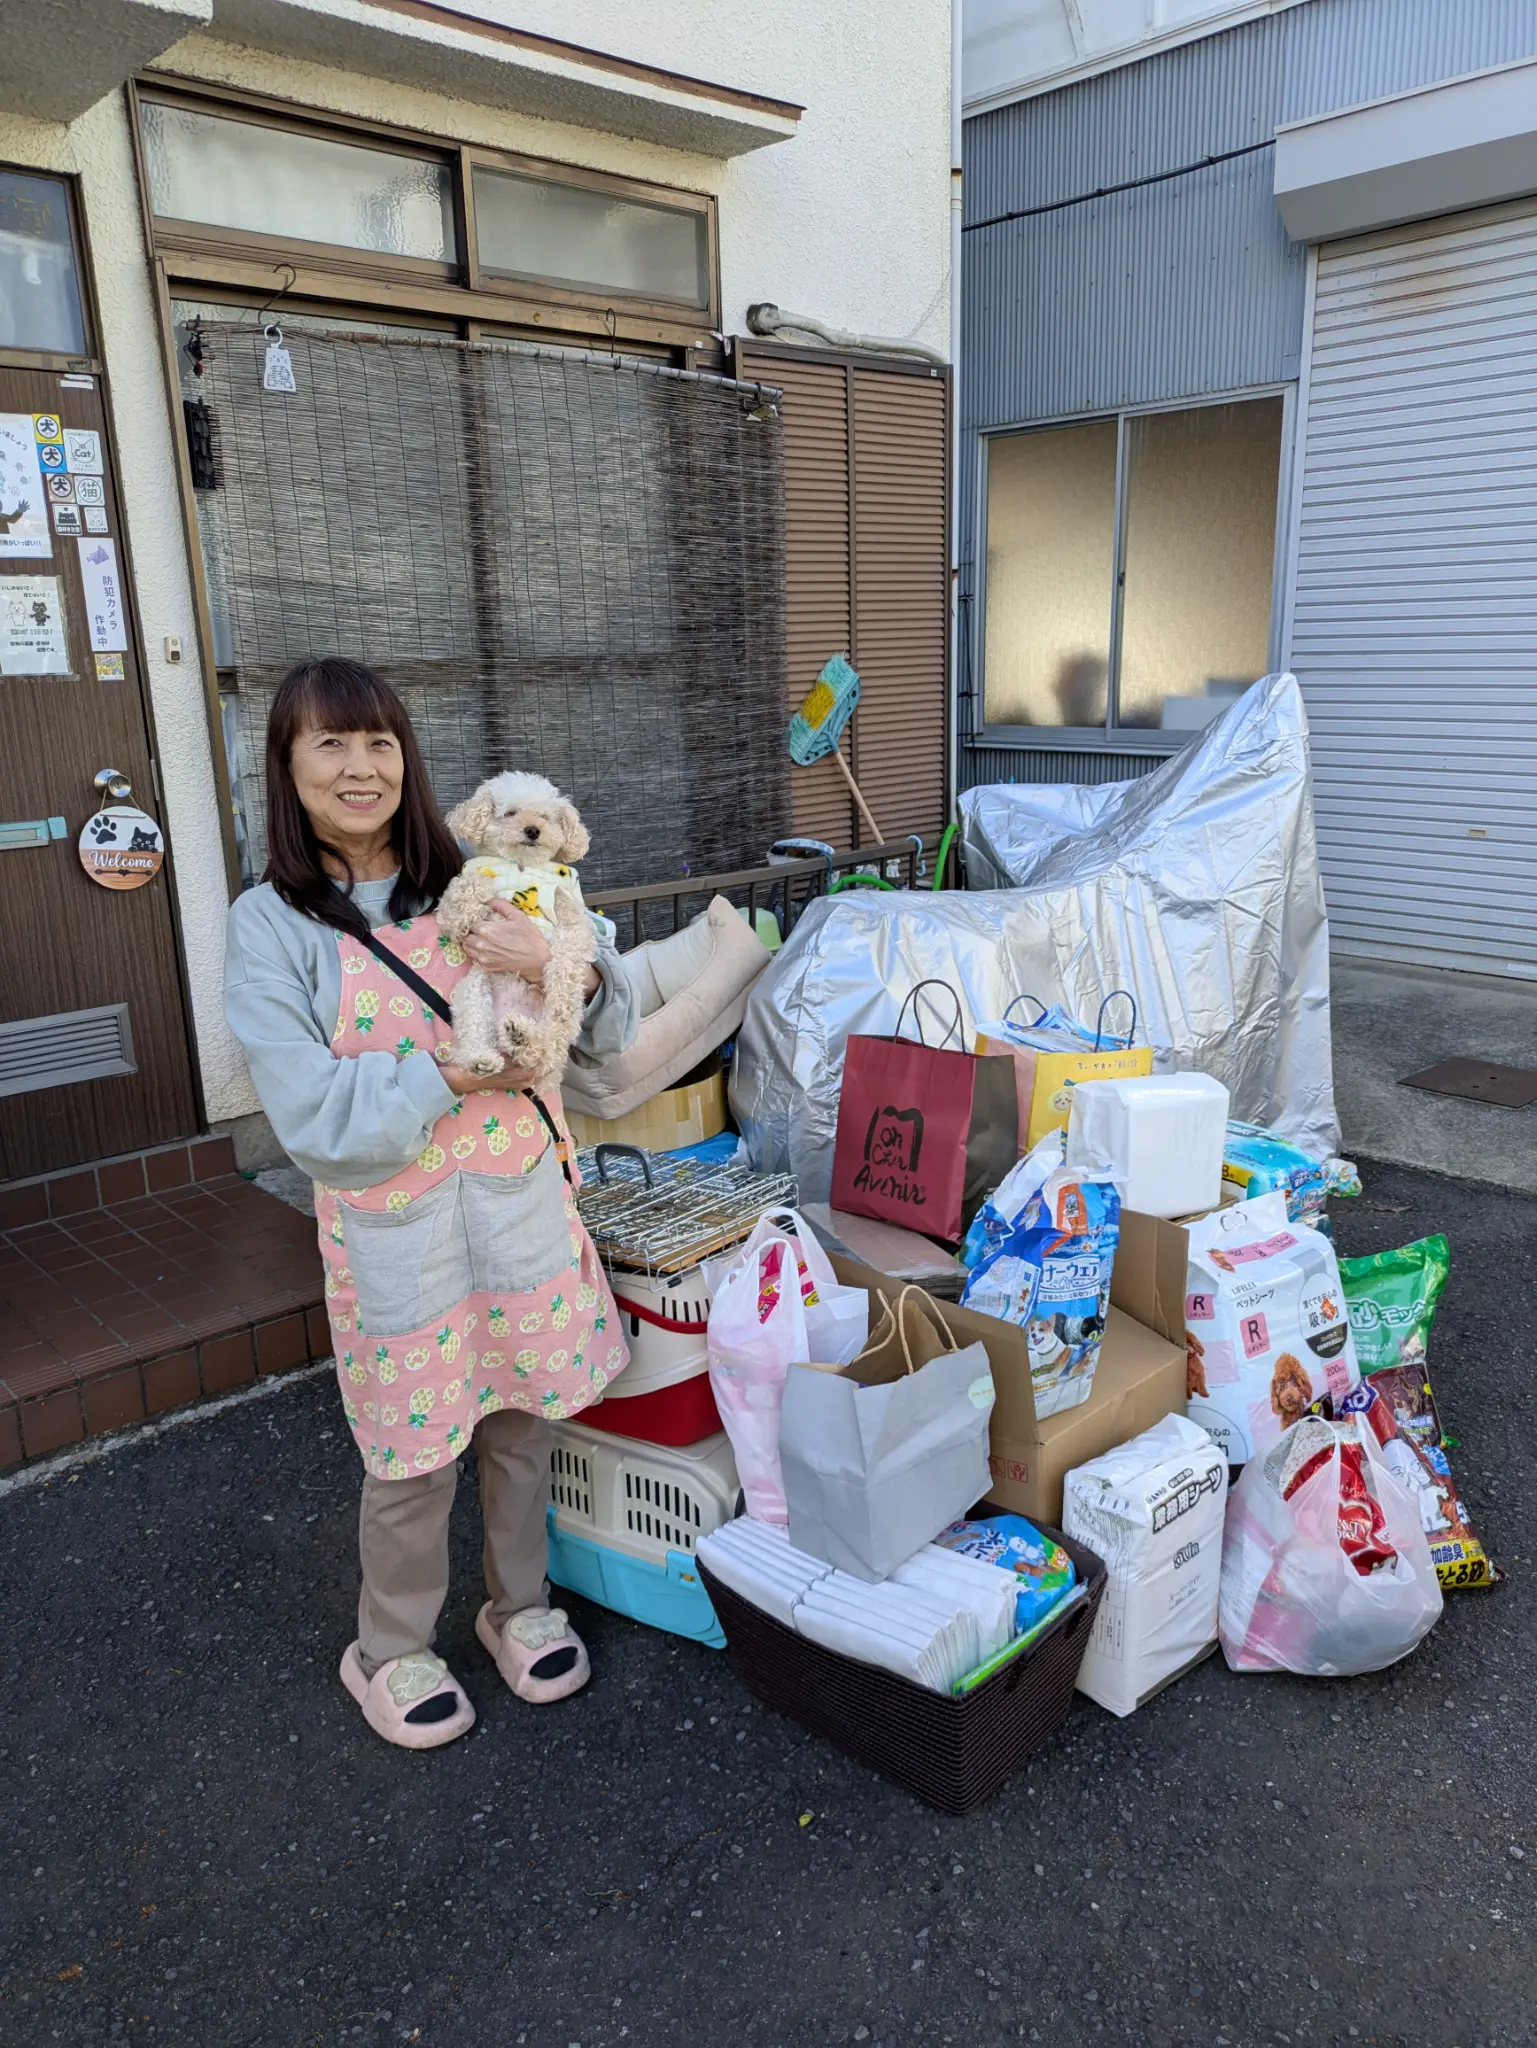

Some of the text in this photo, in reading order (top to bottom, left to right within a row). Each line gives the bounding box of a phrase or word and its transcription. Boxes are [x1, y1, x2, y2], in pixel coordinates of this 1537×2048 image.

[39, 418, 55, 433] 犬
[44, 447, 60, 462] 犬
[74, 449, 92, 458] Cat
[53, 478, 69, 492] 犬
[80, 481, 98, 498] 猫
[102, 575, 118, 631] 防犯カメラ
[94, 615, 108, 648] 作動中
[88, 851, 155, 868] Welcome
[853, 1163, 927, 1205] Avenir
[1231, 1281, 1257, 1295] LIFELEX
[1193, 1296, 1205, 1310] R
[1236, 1288, 1275, 1309] ペットシーツ
[1247, 1319, 1262, 1343] R
[1430, 1542, 1464, 1565] 加齢臭
